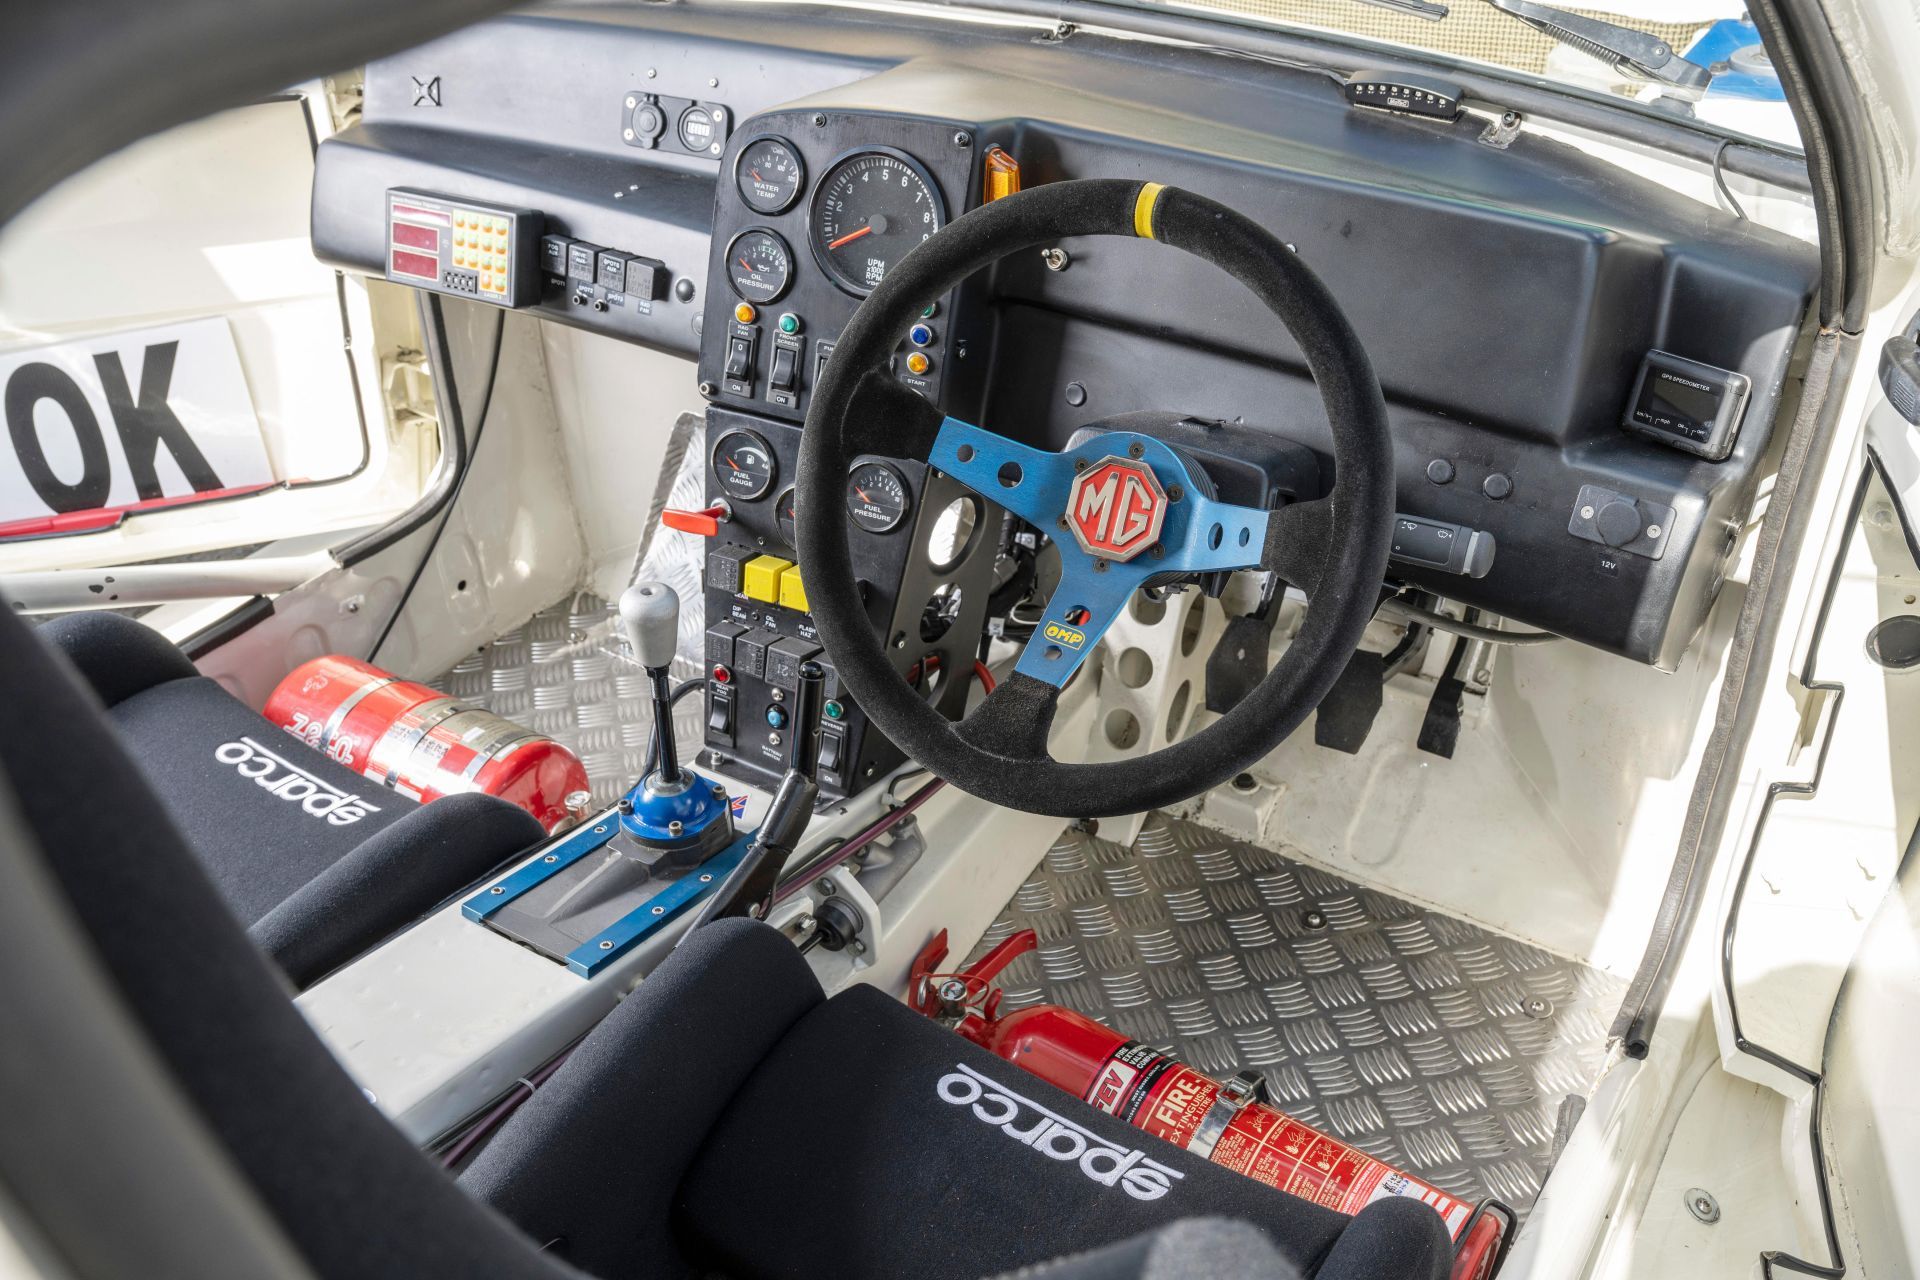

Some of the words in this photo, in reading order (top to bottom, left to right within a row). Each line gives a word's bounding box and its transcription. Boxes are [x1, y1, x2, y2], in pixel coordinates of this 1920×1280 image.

[862, 172, 869, 182] 4
[882, 169, 890, 180] 5
[754, 182, 779, 192] WATER
[902, 176, 908, 187] 6
[756, 190, 776, 198] TEMP
[846, 184, 853, 194] 3
[915, 192, 922, 203] 7
[836, 201, 843, 212] 2
[924, 212, 930, 223] 8
[834, 224, 839, 234] 1
[603, 258, 620, 269] SPOTS
[868, 258, 884, 267] UPM
[866, 272, 882, 282] RPM
[738, 278, 774, 291] PRESSURE
[778, 338, 798, 348] SCREEN
[907, 378, 926, 386] START
[1672, 376, 1710, 392] SPEEDOMETER
[4, 339, 226, 515] OK
[730, 476, 752, 487] GAUGE
[734, 472, 750, 480] FUEL
[864, 504, 882, 514] FUEL
[1079, 472, 1152, 546] MG
[854, 508, 891, 522] PRESSURE
[1601, 560, 1616, 569] 12V
[732, 610, 746, 620] BEAM
[766, 614, 774, 622] OIL
[765, 620, 776, 628] FAN
[798, 624, 816, 634] FLASH
[800, 630, 812, 638] HAZ
[1046, 626, 1082, 644] OMP
[756, 647, 764, 676] BOSCH
[821, 720, 843, 731] REVERSE
[762, 745, 784, 758] BATTERY
[762, 750, 781, 762] SWITCH
[214, 741, 369, 826] sparco
[1116, 1047, 1130, 1059] FIRE
[1130, 1052, 1148, 1066] VALVE
[1156, 1079, 1199, 1128] FIRE
[1170, 1084, 1214, 1144] EXTINGUISHER
[1188, 1116, 1198, 1130] 2.4
[1197, 1096, 1214, 1116] LITRE
[937, 1067, 1176, 1200] sparco
